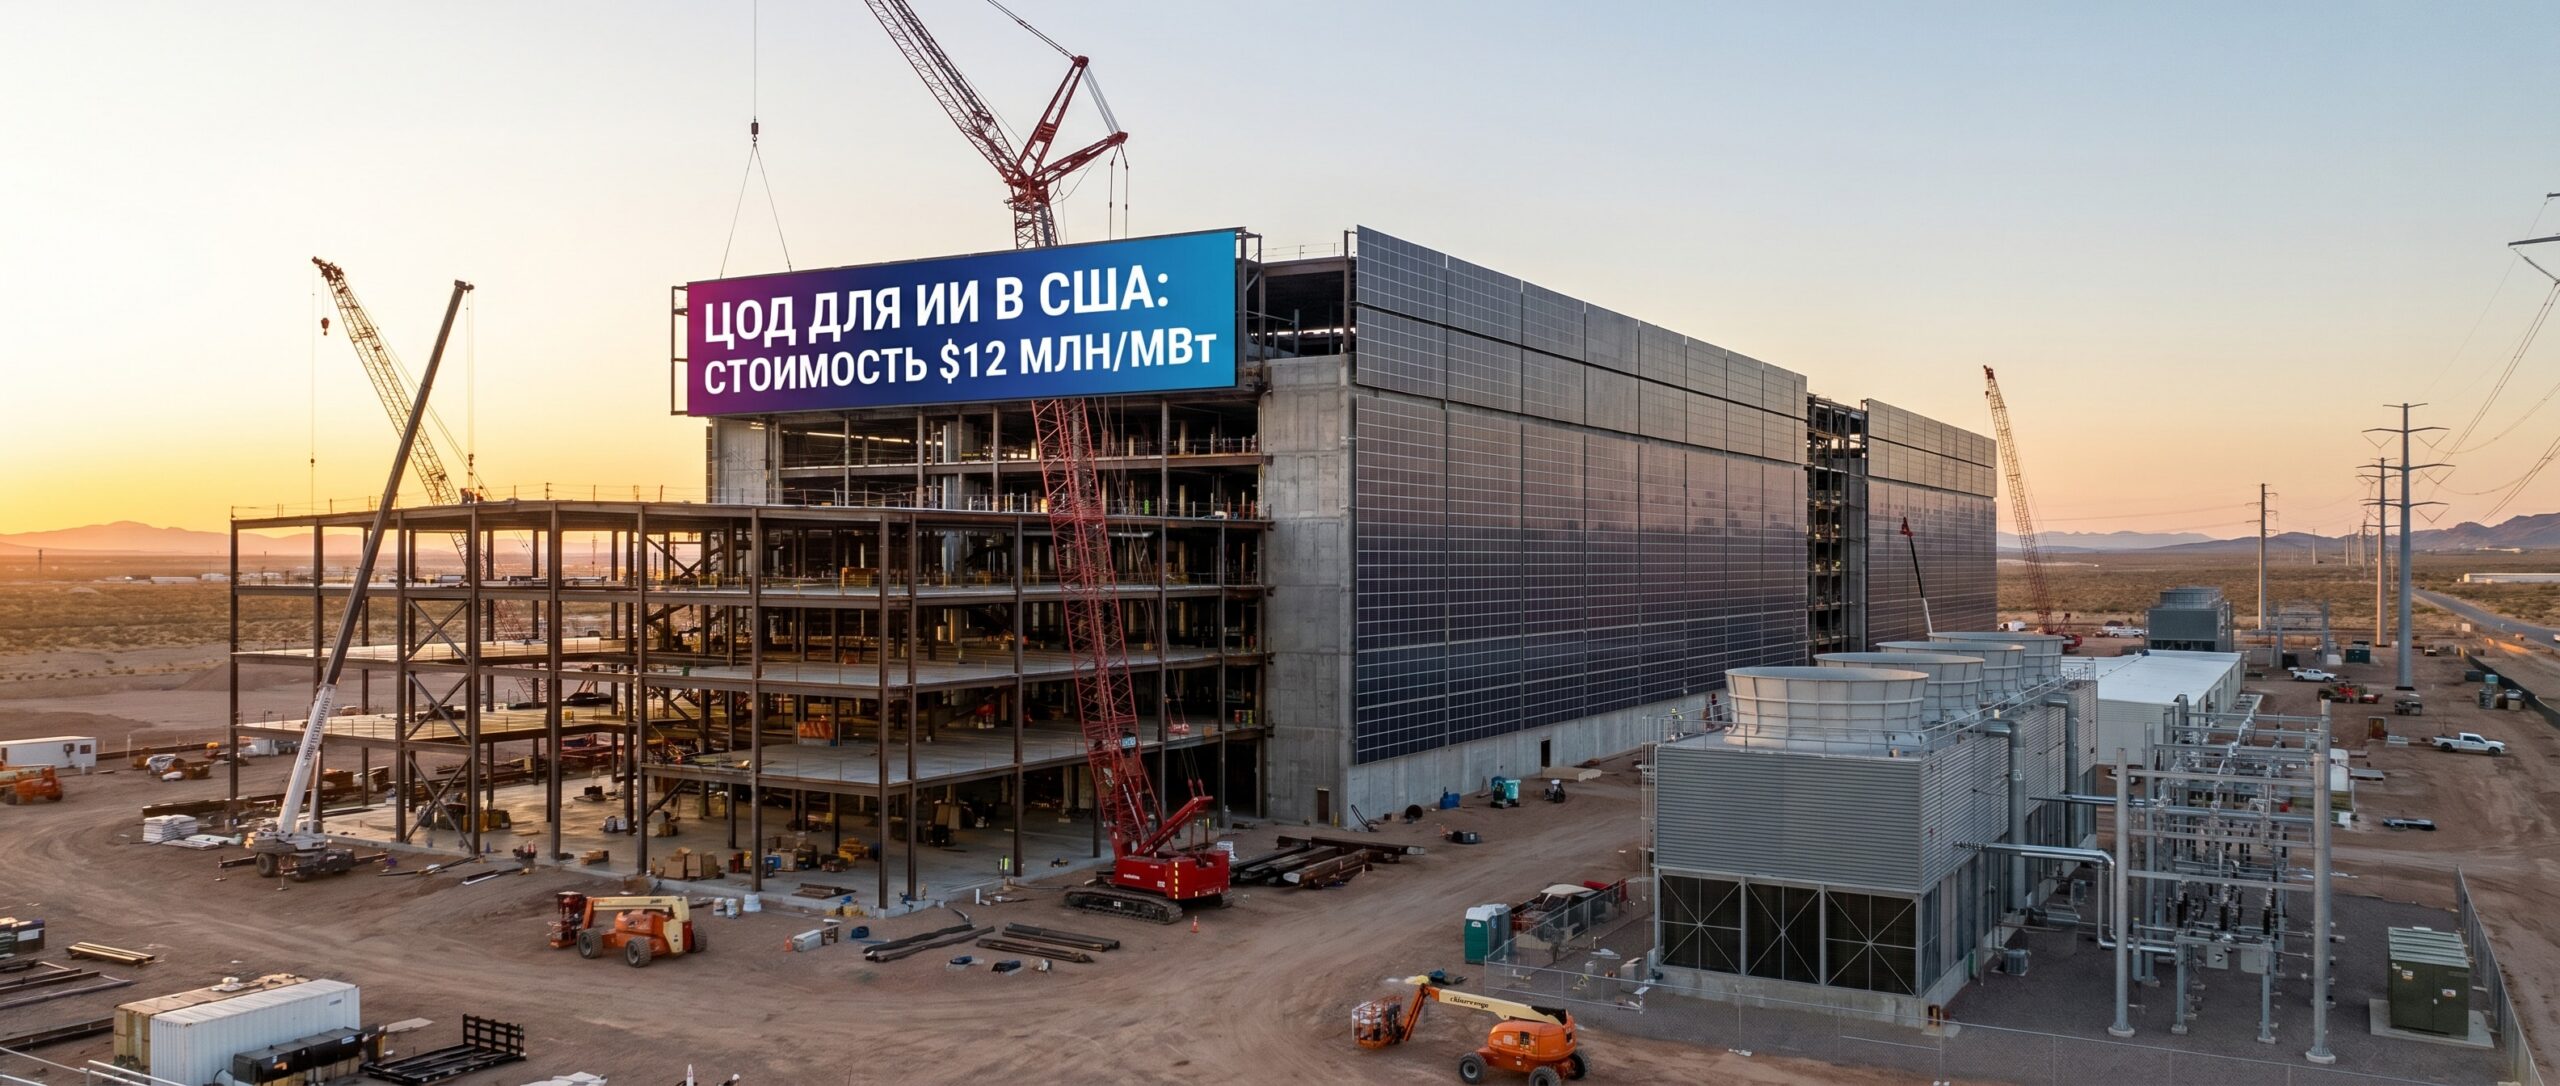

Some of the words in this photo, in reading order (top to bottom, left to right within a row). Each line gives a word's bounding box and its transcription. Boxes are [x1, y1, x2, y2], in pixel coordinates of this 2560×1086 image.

[705, 297, 797, 350] ЦОД
[809, 287, 901, 343] ДЛЯ
[917, 280, 979, 326] ИИ
[997, 277, 1023, 319] В
[1040, 265, 1168, 315] США:
[705, 346, 927, 394] СТОИМОСТЬ
[940, 337, 1008, 384] $12
[1021, 327, 1217, 374] МЛН/МВт
